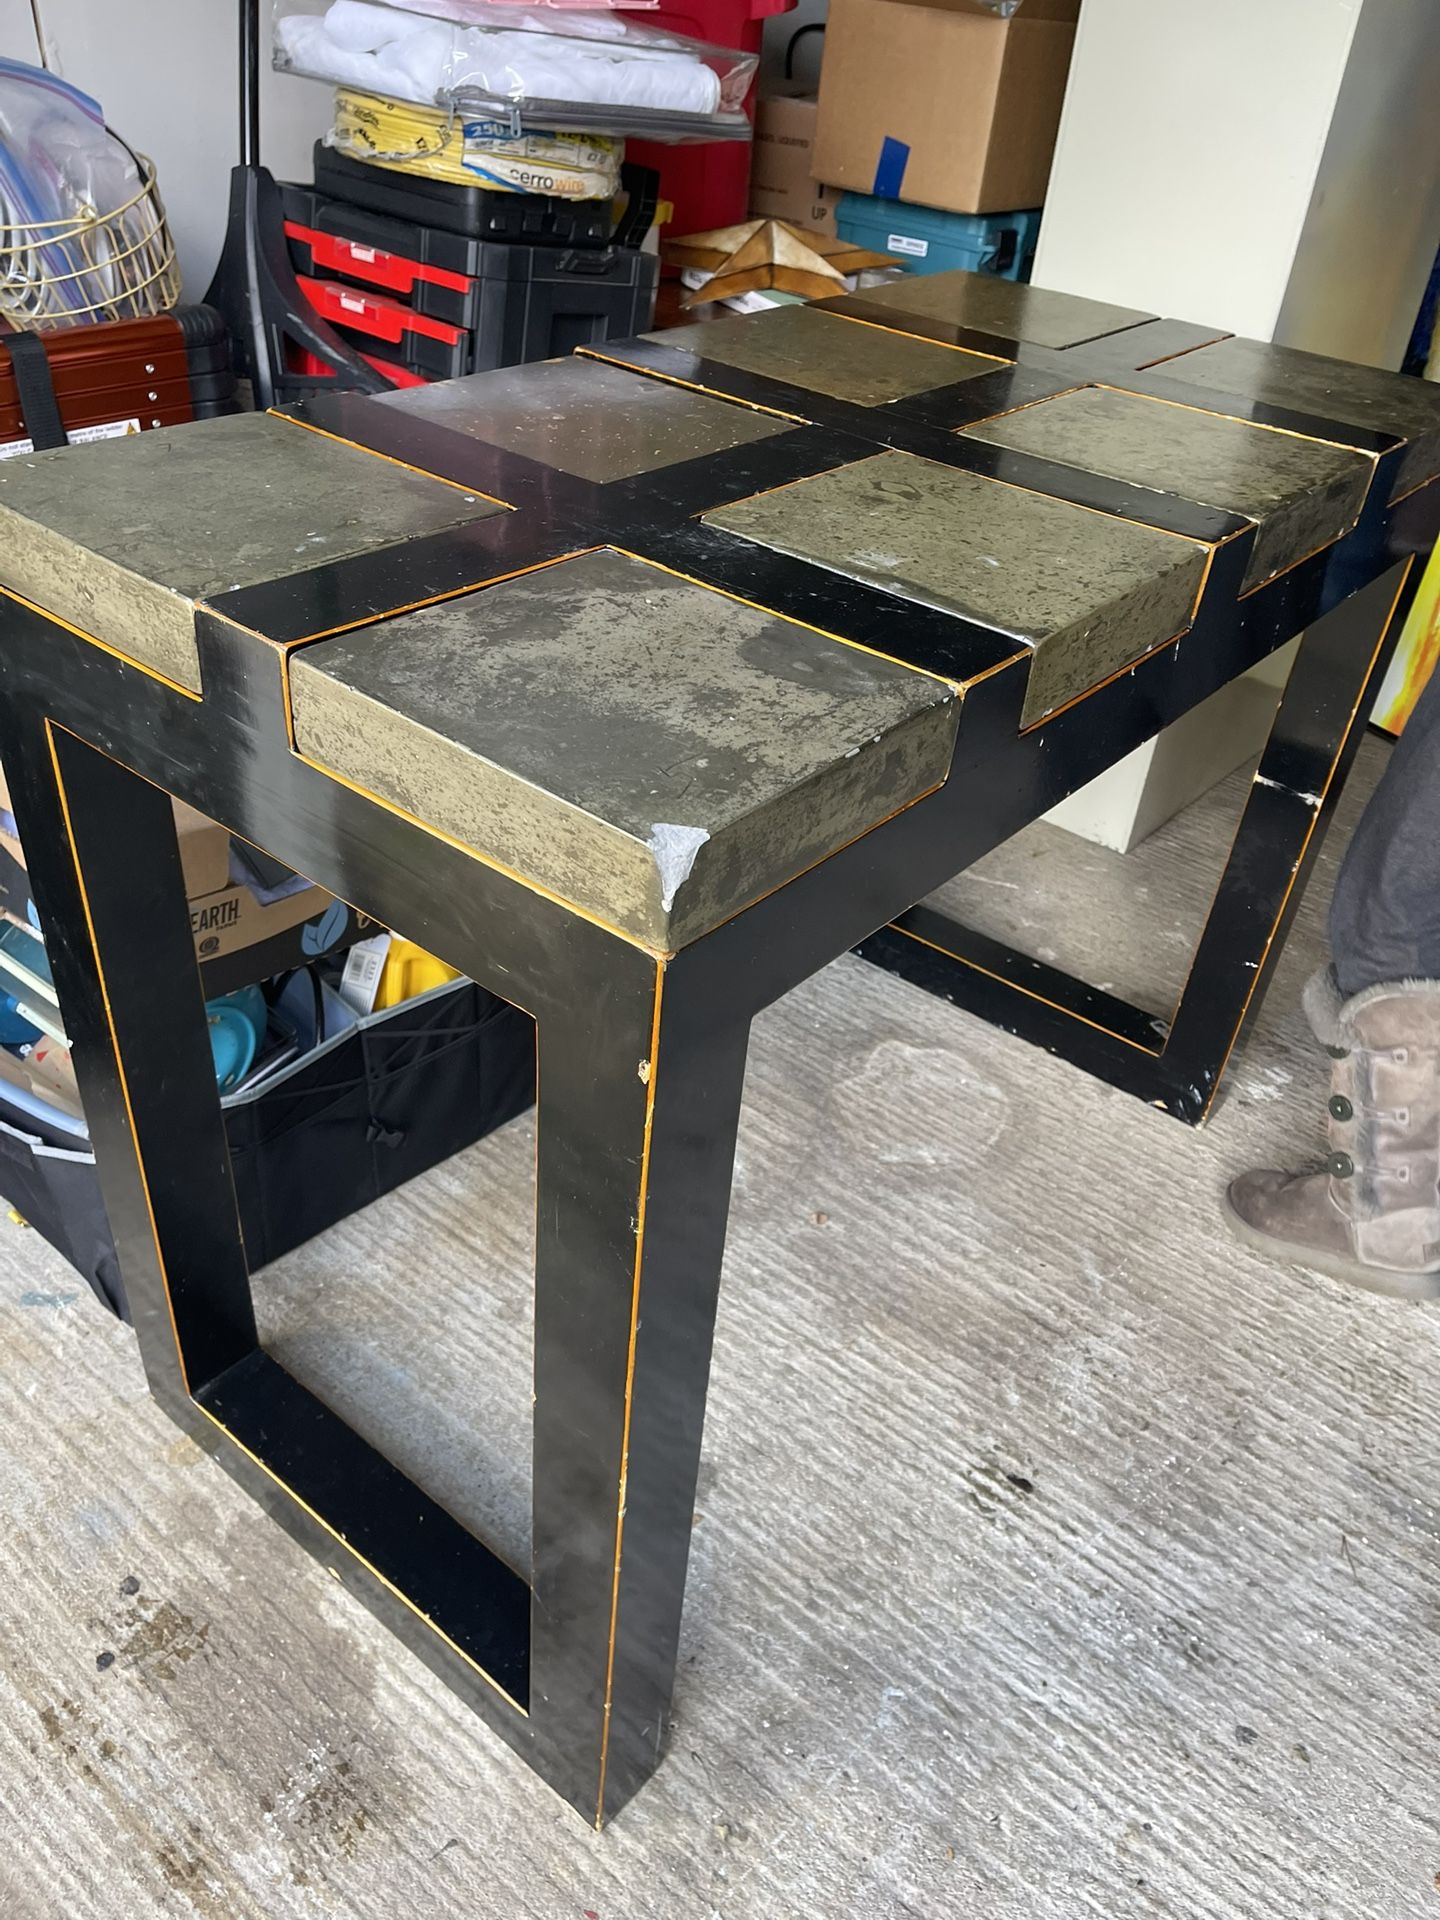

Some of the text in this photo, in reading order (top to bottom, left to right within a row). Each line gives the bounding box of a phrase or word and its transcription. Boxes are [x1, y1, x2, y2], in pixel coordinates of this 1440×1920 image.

[509, 168, 586, 193] cerrowire
[811, 205, 828, 220] UP
[191, 898, 240, 934] EARTH
